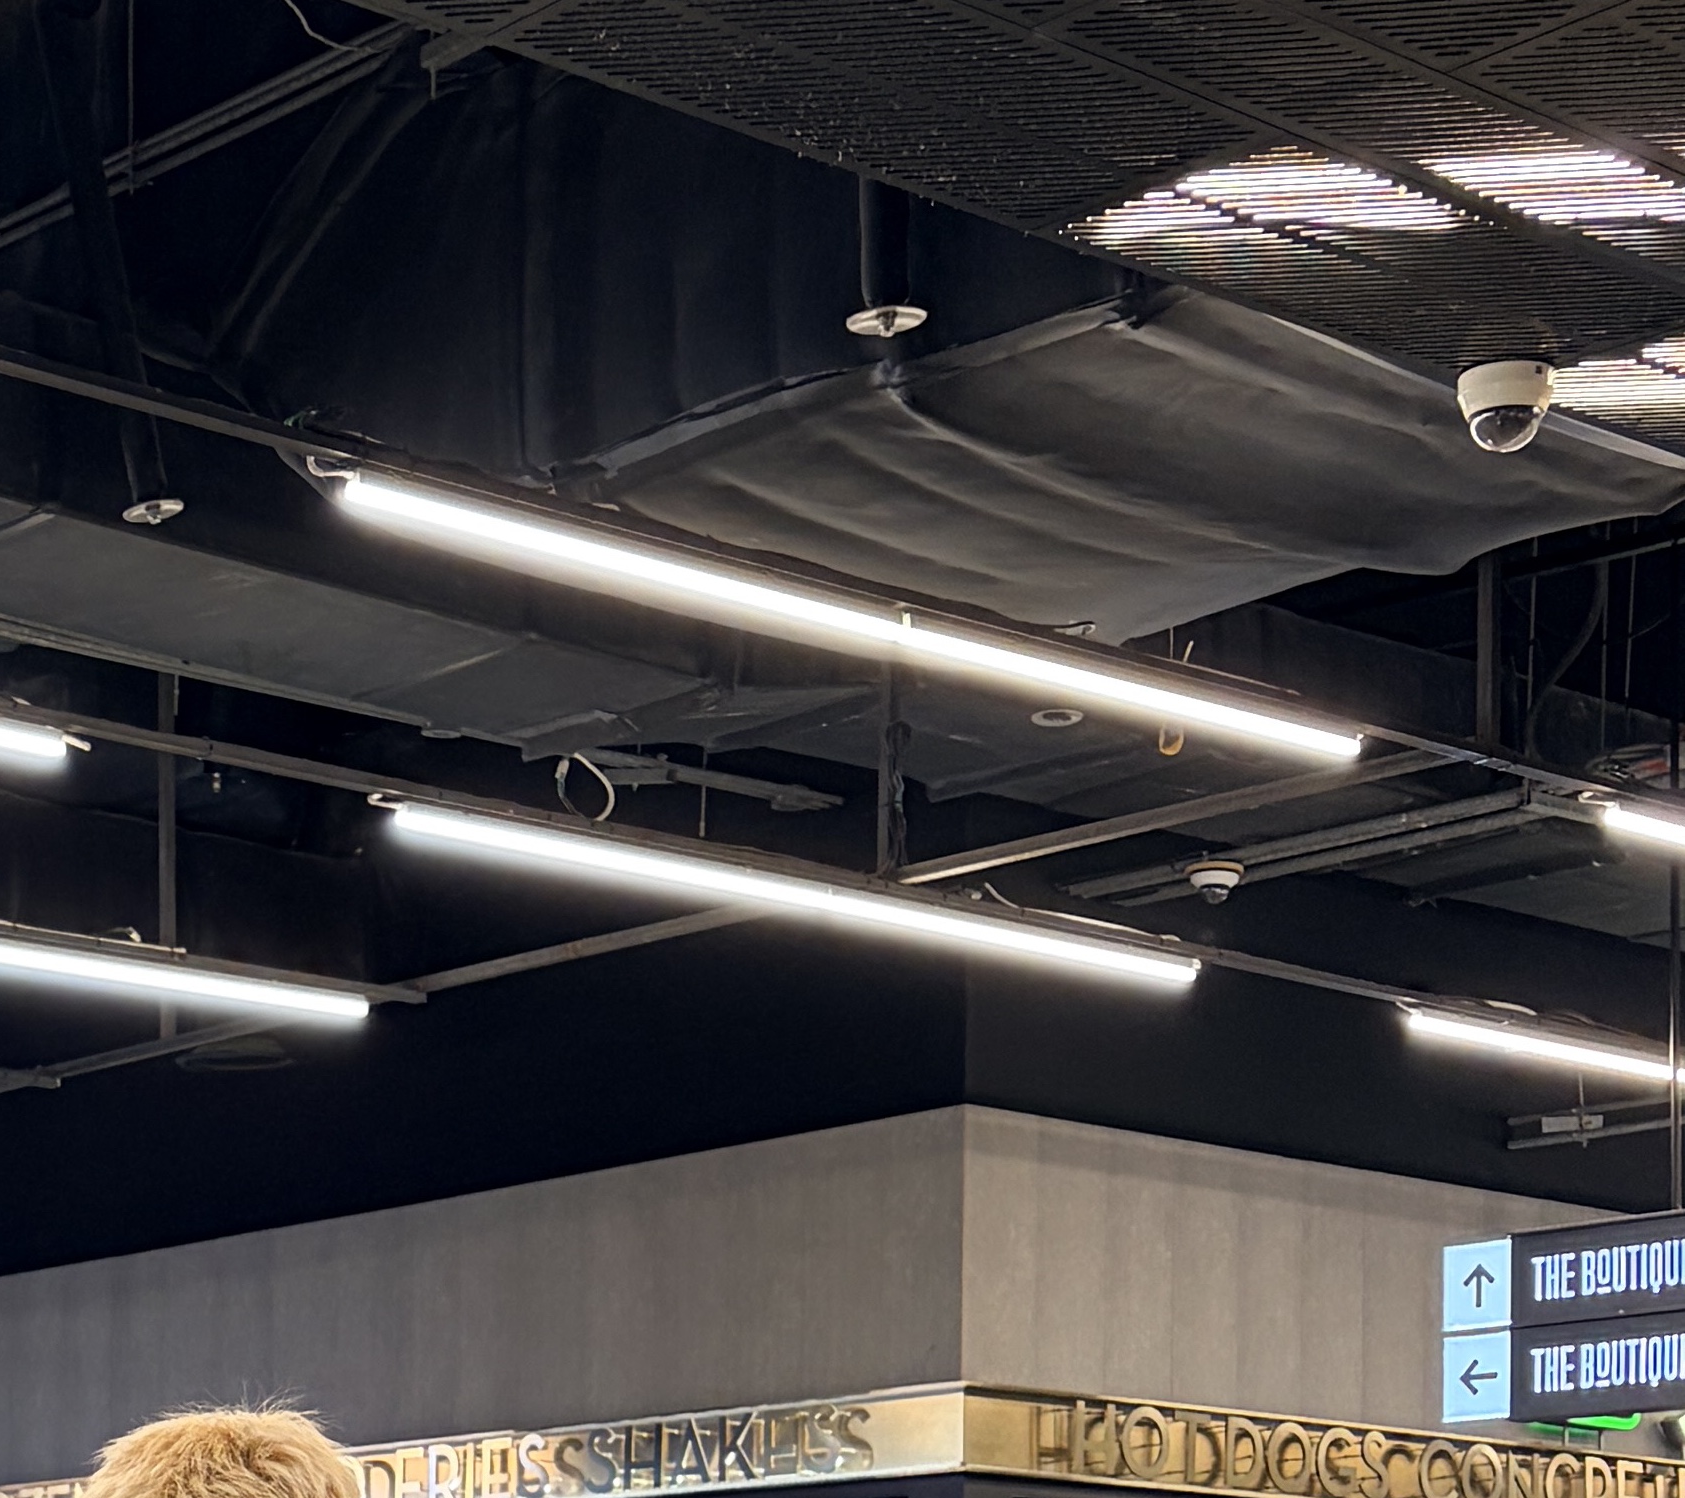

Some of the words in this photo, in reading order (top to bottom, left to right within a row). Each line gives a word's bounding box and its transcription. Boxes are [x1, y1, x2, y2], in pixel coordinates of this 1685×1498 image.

[1530, 1252, 1577, 1302] THE
[1580, 1238, 1685, 1297] BOUTIQU
[1529, 1344, 1577, 1394] THE
[1579, 1332, 1685, 1390] BOUTIQU
[1074, 1399, 1213, 1486] HOT
